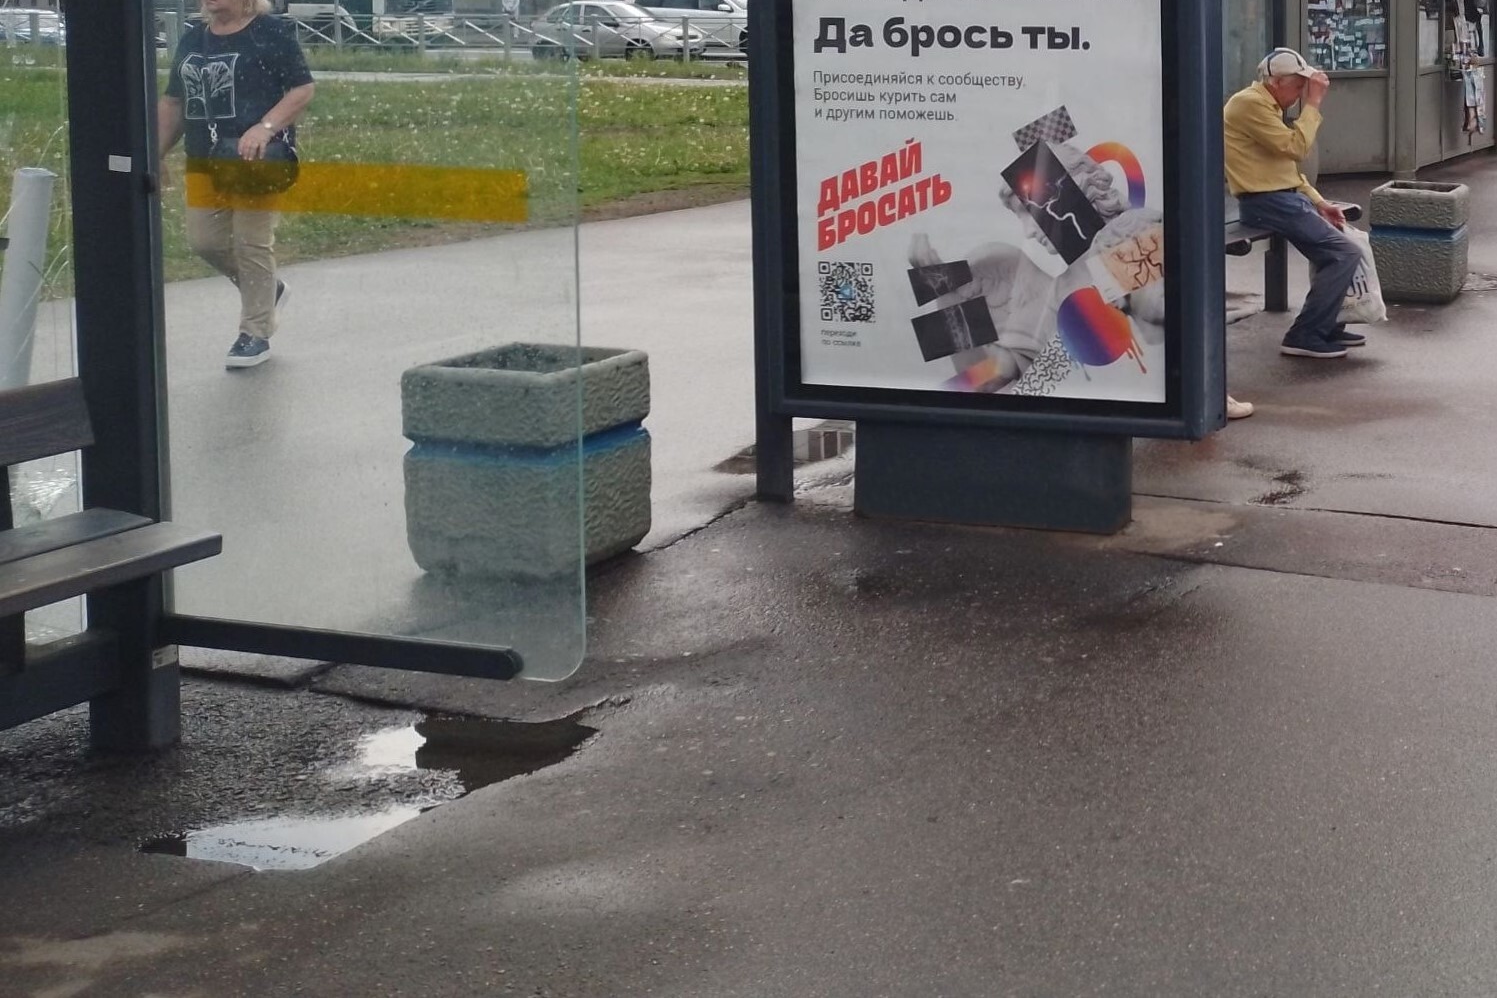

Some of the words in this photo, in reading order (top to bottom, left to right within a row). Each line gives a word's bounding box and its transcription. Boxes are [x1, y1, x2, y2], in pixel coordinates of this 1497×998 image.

[813, 17, 874, 53] Да
[882, 16, 1013, 57] брось
[1021, 26, 1090, 50] ты.
[813, 70, 923, 86] Присоединяйся
[927, 75, 934, 84] к
[814, 88, 875, 103] Бросишь
[879, 91, 926, 105] курить
[930, 93, 957, 103] сам
[815, 108, 822, 118] и
[826, 108, 875, 122] другим
[817, 137, 922, 218] ДАВАЙ
[817, 173, 952, 252] БРОСАТЬ
